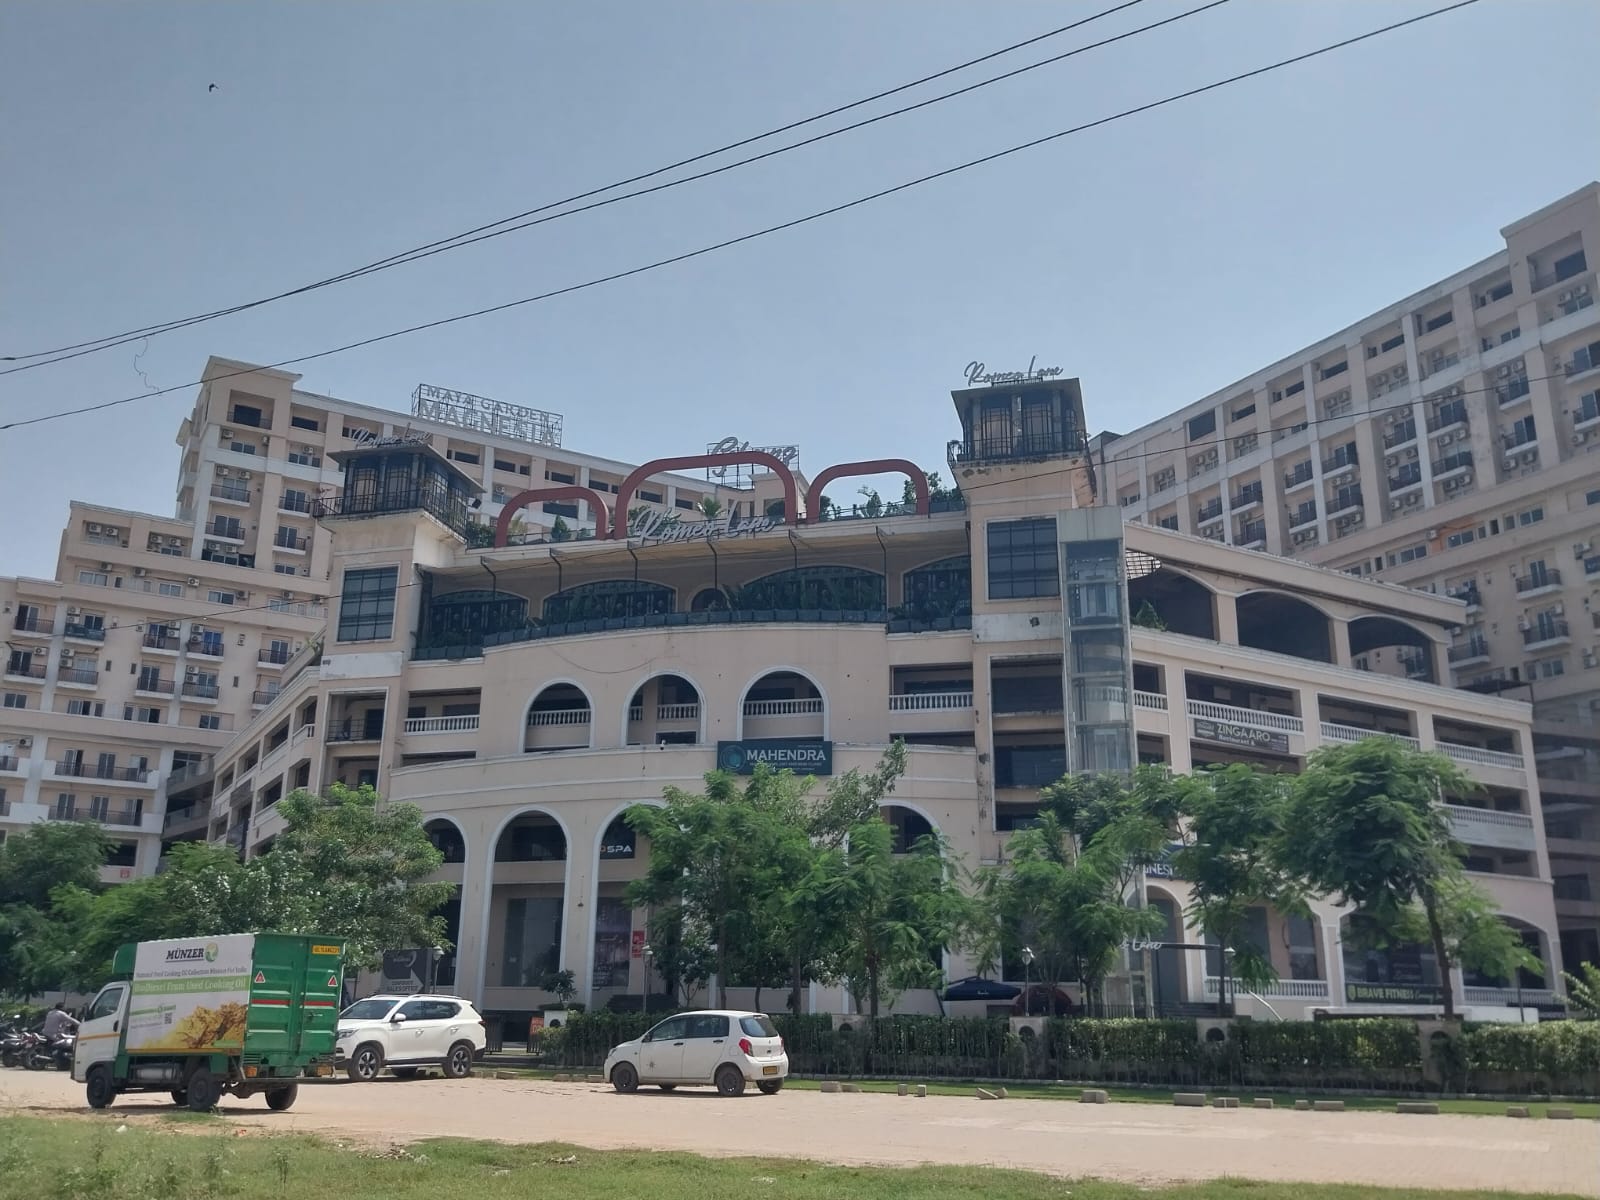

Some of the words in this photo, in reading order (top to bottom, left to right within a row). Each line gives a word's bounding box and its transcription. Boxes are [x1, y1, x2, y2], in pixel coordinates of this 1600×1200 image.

[964, 361, 1024, 387] Romeo
[1028, 355, 1064, 380] Lane
[425, 385, 474, 405] MAYA
[480, 397, 550, 422] GARDEN
[353, 427, 398, 447] Romeo
[402, 422, 433, 444] Lane
[633, 507, 715, 546] Romeo
[723, 500, 776, 538] Lane
[1216, 723, 1271, 742] ZINGAARO
[746, 749, 826, 761] MAHENDRA
[165, 948, 205, 960] MÜNZER
[1357, 987, 1384, 999] BRAVE
